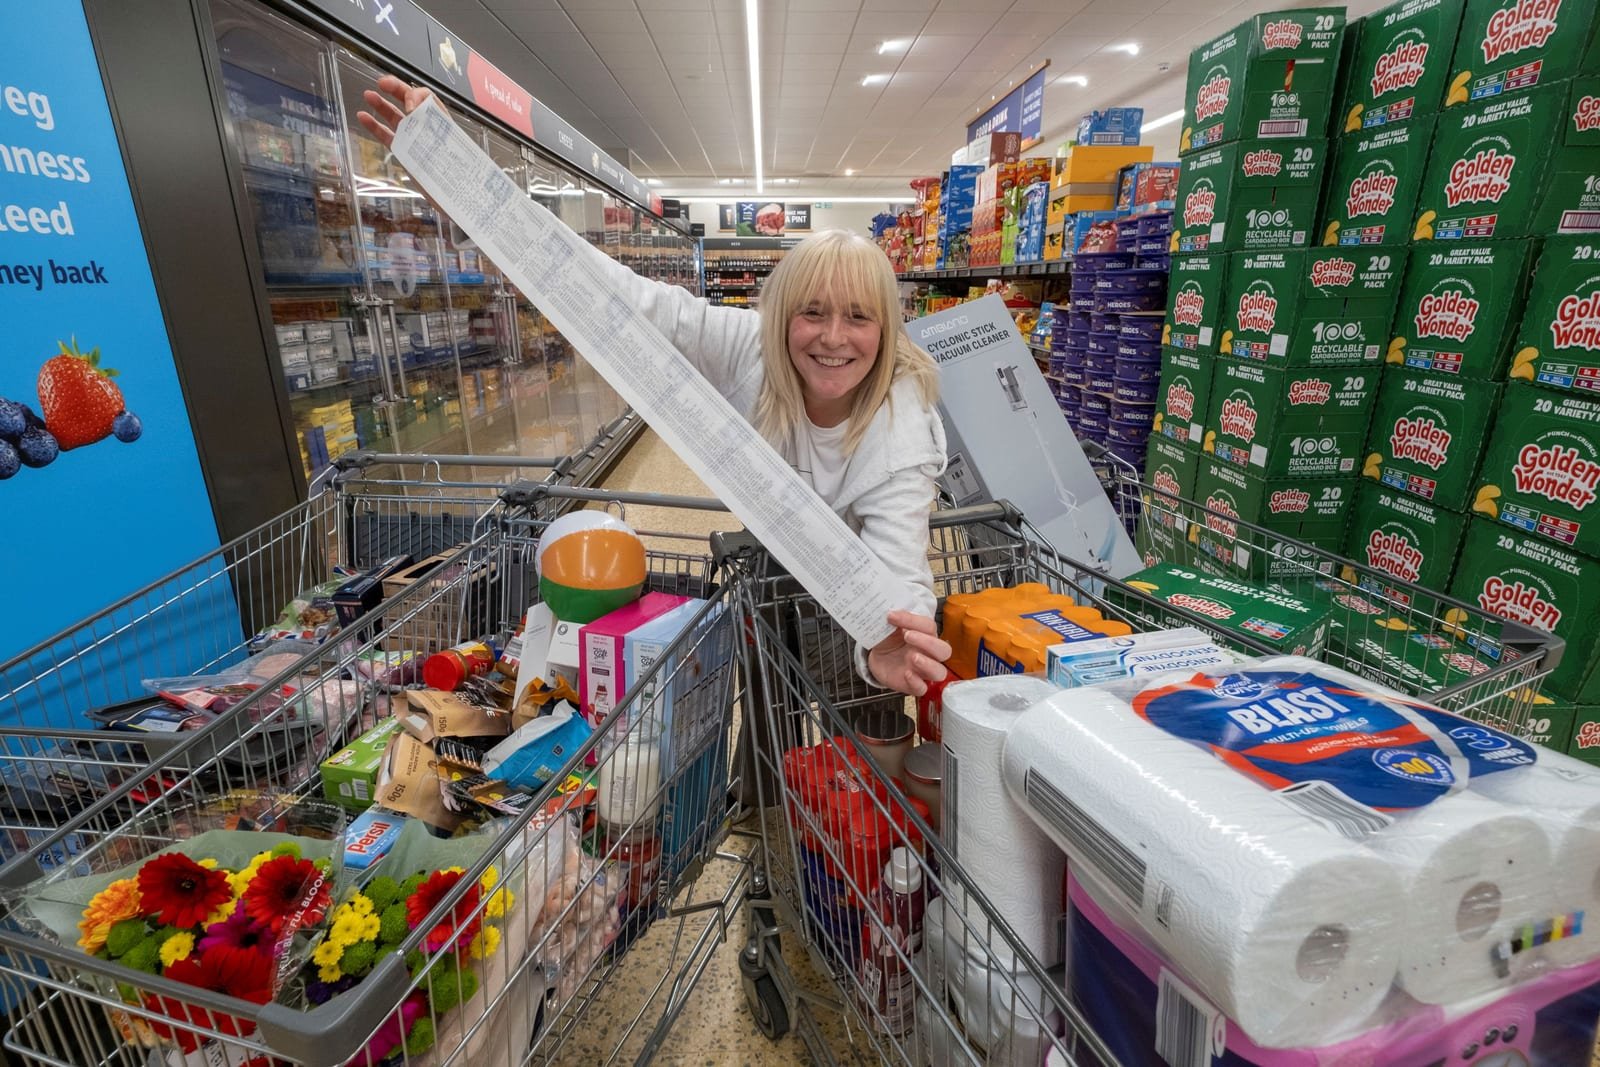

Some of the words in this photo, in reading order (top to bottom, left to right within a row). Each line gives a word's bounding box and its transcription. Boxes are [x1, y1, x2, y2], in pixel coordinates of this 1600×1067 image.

[1315, 15, 1334, 31] 20
[1384, 13, 1395, 27] 20
[1396, 5, 1424, 22] VARIETY
[1423, 0, 1441, 13] PACK
[1488, 0, 1560, 38] Golden
[1263, 33, 1301, 50] Wonder
[1265, 20, 1302, 40] Golden
[1307, 32, 1336, 40] VARIETY
[1481, 19, 1557, 64] Wonder
[1312, 41, 1330, 49] PACK
[1375, 40, 1429, 78] Golden
[1198, 75, 1231, 104] Golden
[1371, 63, 1425, 99] Wonder
[0, 85, 54, 130] eg
[1196, 95, 1228, 123] Wonder
[1461, 114, 1475, 128] 20
[1477, 109, 1510, 125] VARIETY
[1510, 104, 1533, 119] PACK
[1484, 102, 1508, 114] GREAT
[1508, 97, 1530, 110] VALUE
[1357, 141, 1369, 152] 20
[1369, 137, 1391, 150] VARIETY
[1391, 134, 1409, 144] PACK
[1244, 149, 1282, 170] Golden
[1293, 148, 1313, 162] 20
[1242, 160, 1281, 177] Wonder
[1286, 163, 1315, 171] VARIETY
[1450, 149, 1516, 186] Golden
[1350, 170, 1398, 198] Golden
[1445, 176, 1512, 208] Wonder
[1186, 187, 1216, 212] Golden
[1347, 193, 1394, 219] Wonder
[1183, 207, 1214, 229] Wonder
[1246, 230, 1291, 238] RECYCLABLE
[1368, 256, 1391, 271] 20
[1429, 254, 1442, 265] 20
[1443, 256, 1474, 265] VARIETY
[1474, 254, 1495, 264] PACK
[1572, 246, 1592, 259] 20
[48, 259, 108, 284] back
[1313, 257, 1356, 277] Golden
[1359, 272, 1393, 280] VARIETY
[1310, 271, 1354, 287] Wonder
[1175, 289, 1204, 312] Golden
[1239, 289, 1277, 318] Golden
[1419, 290, 1479, 322] Golden
[1173, 306, 1202, 328] Wonder
[1237, 310, 1275, 334] Wonder
[1414, 312, 1474, 343] Wonder
[927, 331, 971, 353] CYCLONIC
[971, 322, 997, 337] STICK
[1313, 321, 1366, 343] 100%
[933, 344, 972, 364] VACUUM
[972, 330, 1010, 350] CLEANER
[1312, 344, 1363, 353] RECYCLABLE
[1117, 389, 1138, 397] HEROES
[1290, 378, 1331, 398] Golden
[1335, 391, 1367, 399] VARIETY
[1344, 377, 1365, 391] 20
[1404, 379, 1416, 392] 20
[1417, 384, 1443, 396] VARIETY
[1443, 389, 1466, 400] PACK
[1423, 378, 1442, 388] GREAT
[1443, 381, 1463, 392] VALUE
[1168, 383, 1194, 413] Golden
[1288, 391, 1330, 405] Wonder
[1562, 398, 1592, 412] GREAT
[1166, 398, 1193, 423] Wonder
[1222, 399, 1257, 428] Golden
[1533, 398, 1552, 413] 20
[1554, 405, 1596, 422] VARIETY
[1220, 415, 1255, 443] Wonder
[1394, 416, 1451, 450] Golden
[1390, 434, 1447, 470] Wonder
[1577, 436, 1598, 458] CRUNCH
[1289, 457, 1339, 466] RECYCLABLE
[1520, 443, 1600, 489] Golden
[1271, 489, 1310, 508] Golden
[1322, 488, 1342, 499] 20
[1512, 464, 1597, 511] Wonder
[1269, 500, 1309, 514] Wonder
[1379, 495, 1391, 507] 20
[1391, 501, 1417, 517] VARIETY
[1417, 509, 1437, 524] PACK
[1397, 497, 1415, 508] GREAT
[1416, 503, 1434, 515] VALUE
[1369, 529, 1424, 569] Golden
[1497, 536, 1514, 550] 20
[1515, 543, 1554, 567] VARIETY
[1554, 558, 1582, 576] PACK
[1523, 540, 1549, 555] GREAT
[1549, 549, 1577, 565] VALUE
[1166, 569, 1197, 579] 20
[1366, 546, 1420, 584] Wonder
[1200, 578, 1264, 599] VARIETY
[1264, 597, 1311, 613] PACK
[1214, 578, 1258, 593] GREAT
[1259, 590, 1303, 605] VALUE
[1484, 576, 1561, 626] Golden
[1168, 597, 1230, 620] Wonder
[1170, 593, 1236, 616] Golden
[1033, 612, 1094, 640] IRN-BRU
[1135, 646, 1219, 663] SENSODYNE
[1145, 658, 1222, 672] SENSODYNE
[1227, 686, 1351, 735] BLAST
[1526, 718, 1551, 733] 20
[387, 783, 406, 802] 150g
[347, 822, 391, 854] Persil
[301, 866, 330, 908] BLOOMS
